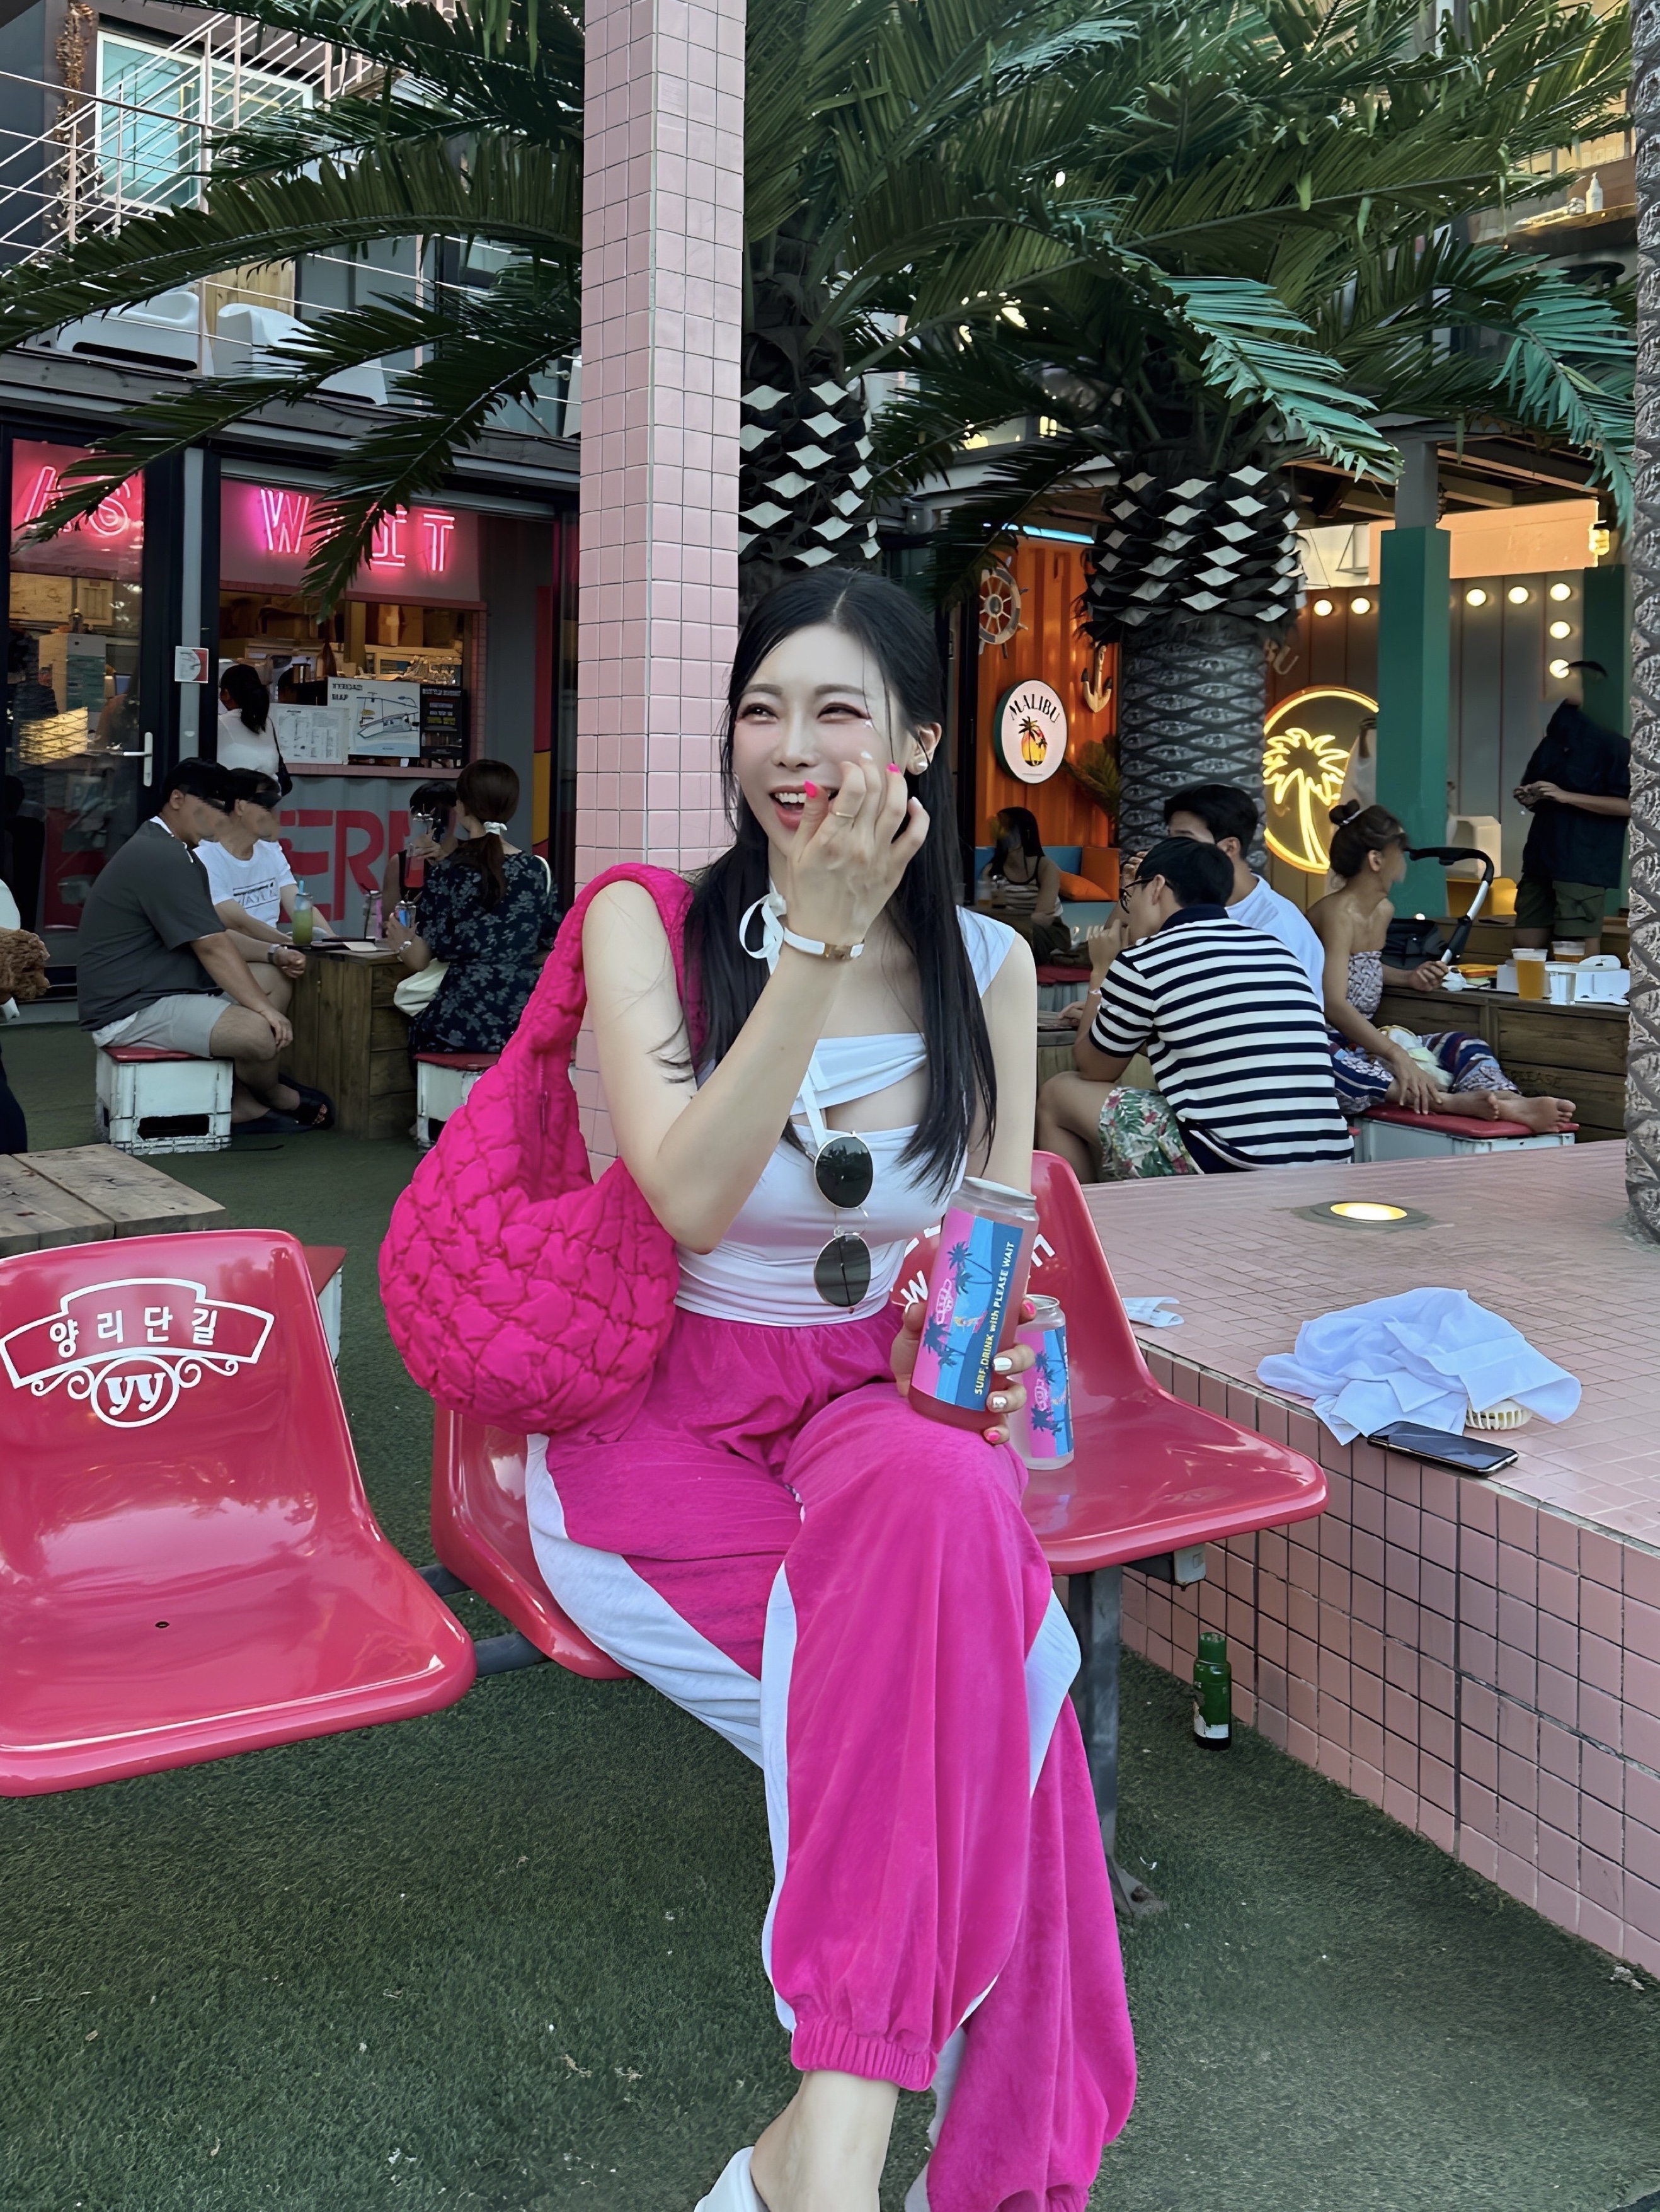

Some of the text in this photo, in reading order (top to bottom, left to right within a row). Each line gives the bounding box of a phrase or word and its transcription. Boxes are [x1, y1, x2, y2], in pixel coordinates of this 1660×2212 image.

[260, 489, 455, 571] WIT
[1009, 693, 1060, 724] MALIBU
[993, 1269, 1009, 1308] PLEASE
[1002, 1241, 1015, 1268] WAIT
